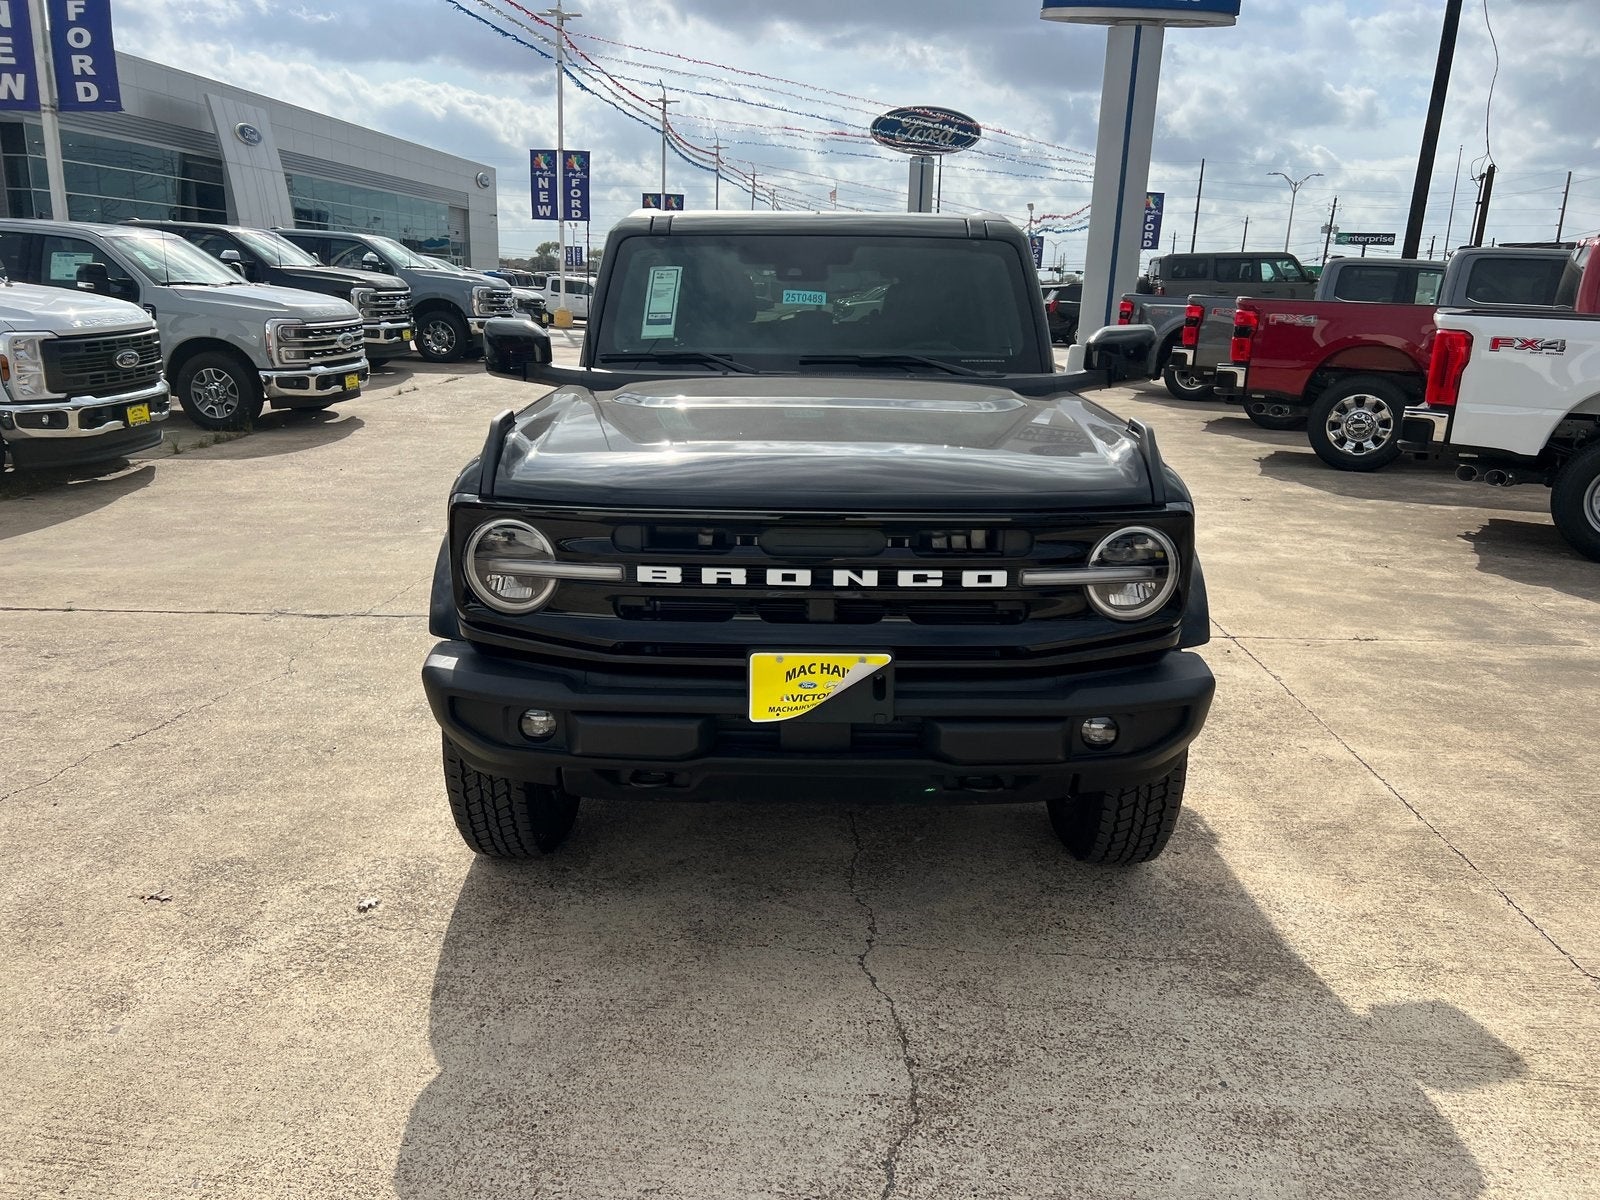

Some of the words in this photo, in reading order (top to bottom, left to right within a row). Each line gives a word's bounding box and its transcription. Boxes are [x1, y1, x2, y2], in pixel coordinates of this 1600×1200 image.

[67, 1, 99, 102] FORD
[537, 178, 552, 216] NEW
[570, 179, 582, 218] FORD
[1143, 215, 1155, 247] FORD
[1339, 234, 1394, 243] enterprise
[785, 293, 823, 303] 25T0489
[1269, 313, 1318, 325] FX4
[1489, 337, 1566, 352] FX4
[636, 565, 1008, 588] BRONCO
[785, 663, 816, 682] MAC
